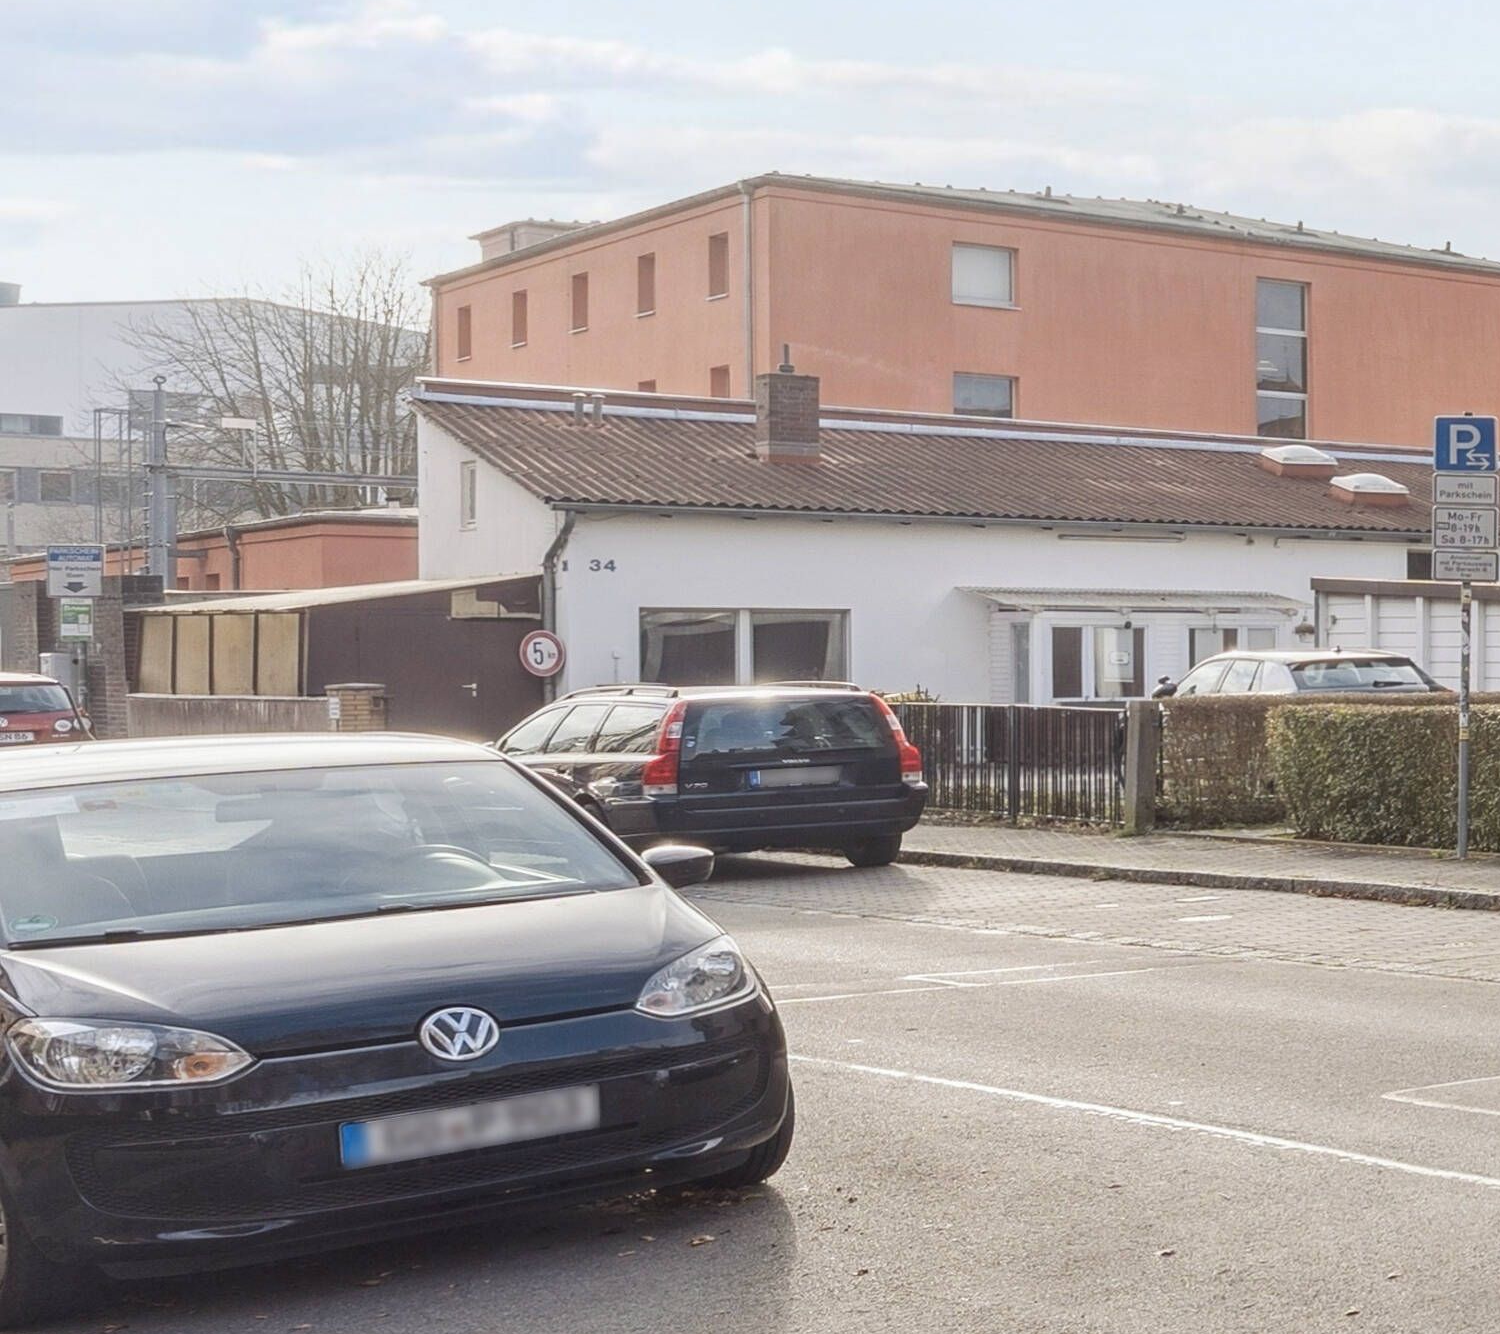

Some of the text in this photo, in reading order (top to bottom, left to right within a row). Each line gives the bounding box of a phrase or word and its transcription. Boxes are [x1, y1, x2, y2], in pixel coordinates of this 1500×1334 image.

[1449, 424, 1481, 465] P
[1440, 490, 1492, 499] Parkschein
[1448, 512, 1482, 521] Mo-Fr
[1450, 523, 1480, 532] 8-19h
[1441, 534, 1489, 544] Sa 8-17h
[589, 559, 616, 572] 34
[533, 642, 544, 665] 5
